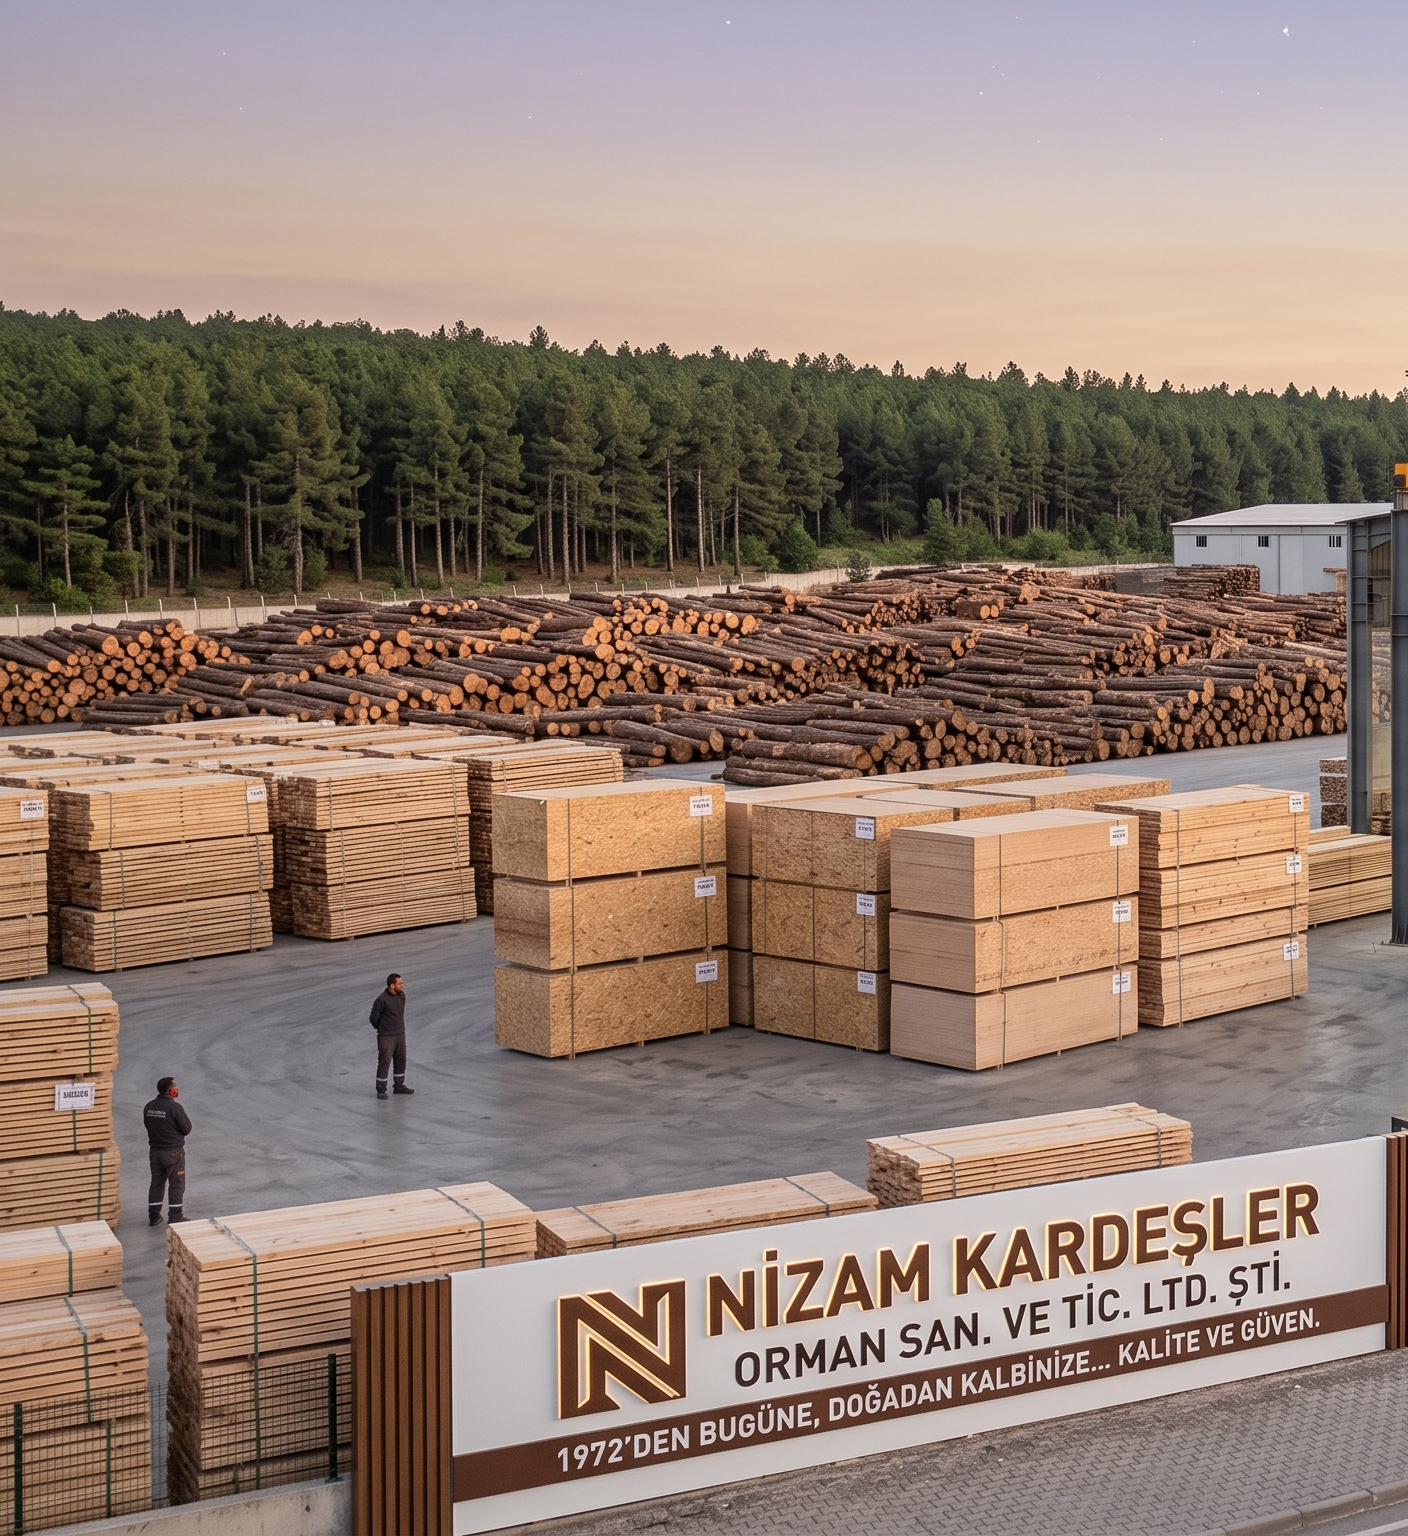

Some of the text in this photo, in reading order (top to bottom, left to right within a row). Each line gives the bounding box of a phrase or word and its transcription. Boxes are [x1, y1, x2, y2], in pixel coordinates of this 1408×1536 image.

[706, 1182, 1321, 1338] NİZAM KARDEŞLER
[734, 1250, 1291, 1388] ORMAN SAN. VE TİC. LTD. ŞTİ.
[557, 1307, 1320, 1473] 1972'DEN BUGÜNE, DOĞADAN KALBİNİZE... KALİTE VE GÜVEN.
